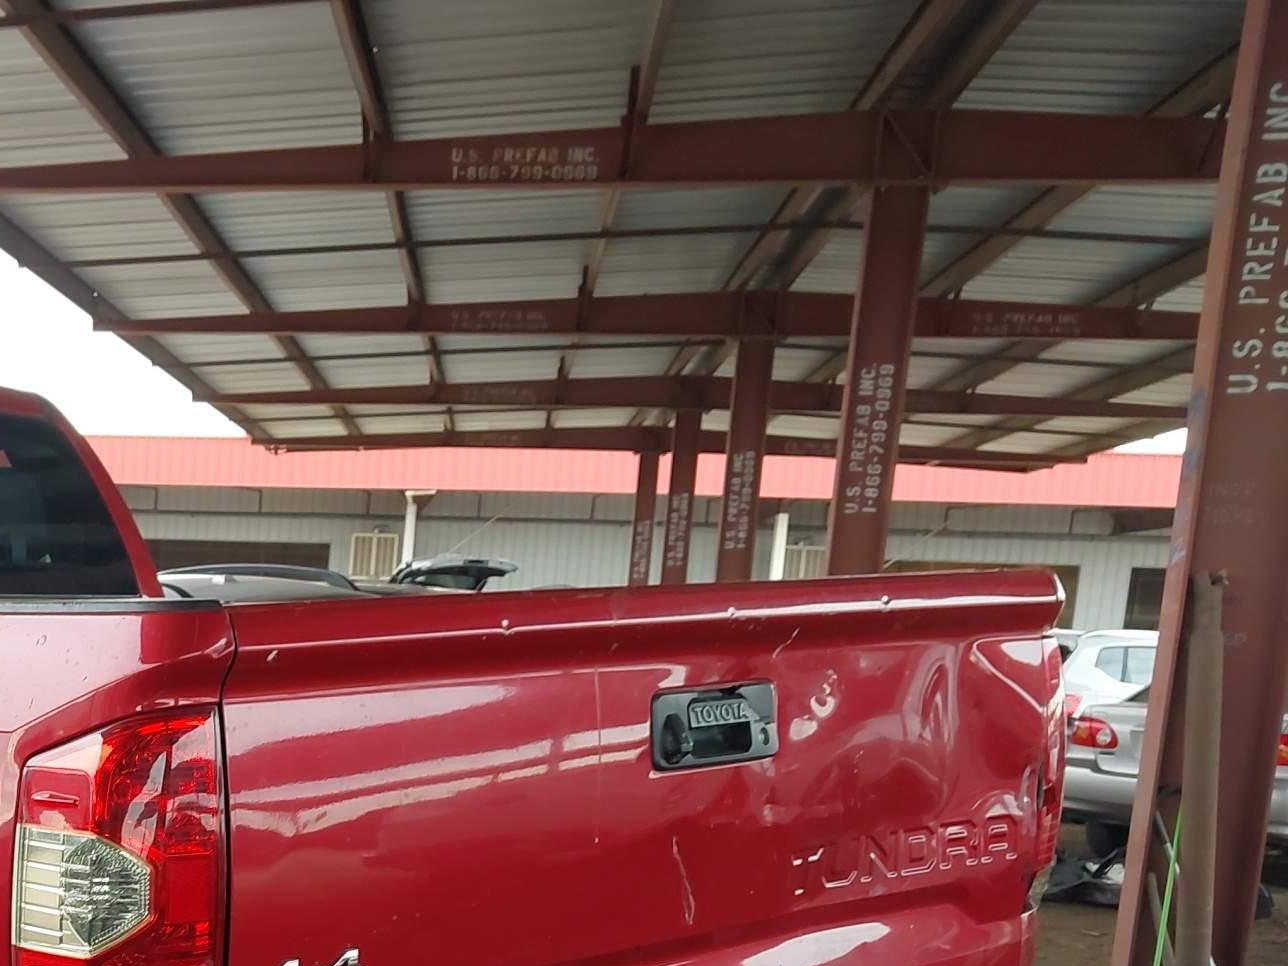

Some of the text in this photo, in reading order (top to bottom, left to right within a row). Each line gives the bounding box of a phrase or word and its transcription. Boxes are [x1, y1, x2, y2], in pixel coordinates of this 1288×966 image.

[1239, 162, 1288, 304] PREFAB
[1226, 327, 1265, 394] U.S.
[849, 404, 872, 472] PREFAB
[862, 363, 895, 513] 1-866-799-0969
[691, 703, 750, 725] TOYOTA
[791, 815, 1018, 895] TUNDRA
